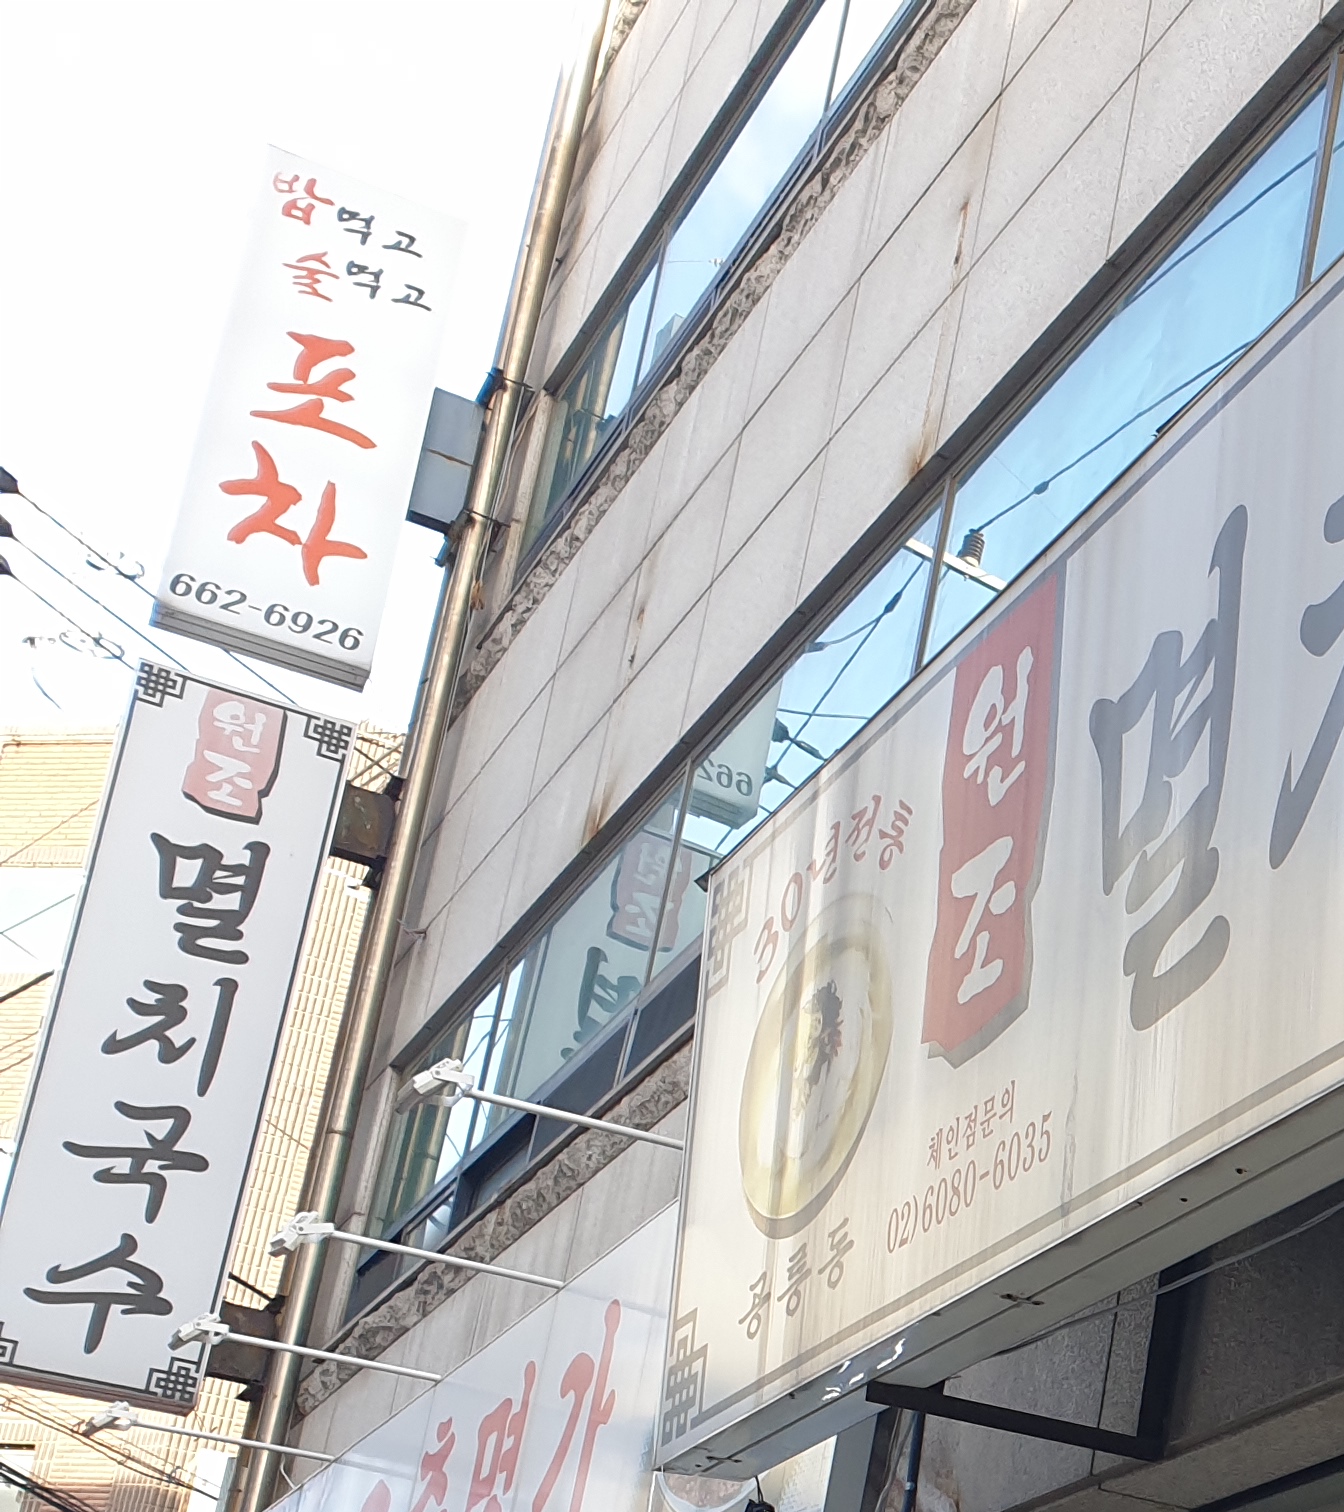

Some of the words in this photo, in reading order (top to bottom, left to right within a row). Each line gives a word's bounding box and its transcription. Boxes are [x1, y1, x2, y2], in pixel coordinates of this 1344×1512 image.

[272, 170, 426, 260] 밥먹고
[282, 250, 433, 313] 술먹고
[218, 330, 378, 587] 포차
[168, 571, 364, 652] 662-6926
[207, 698, 268, 808] 원조
[948, 645, 1036, 1005] 원조
[752, 793, 917, 985] 30년전통
[23, 832, 271, 1354] 멸치국수
[926, 1079, 1018, 1170] 체인점문의
[885, 1112, 1053, 1255] 02)6080-6035
[737, 1216, 857, 1341] 공릉동
